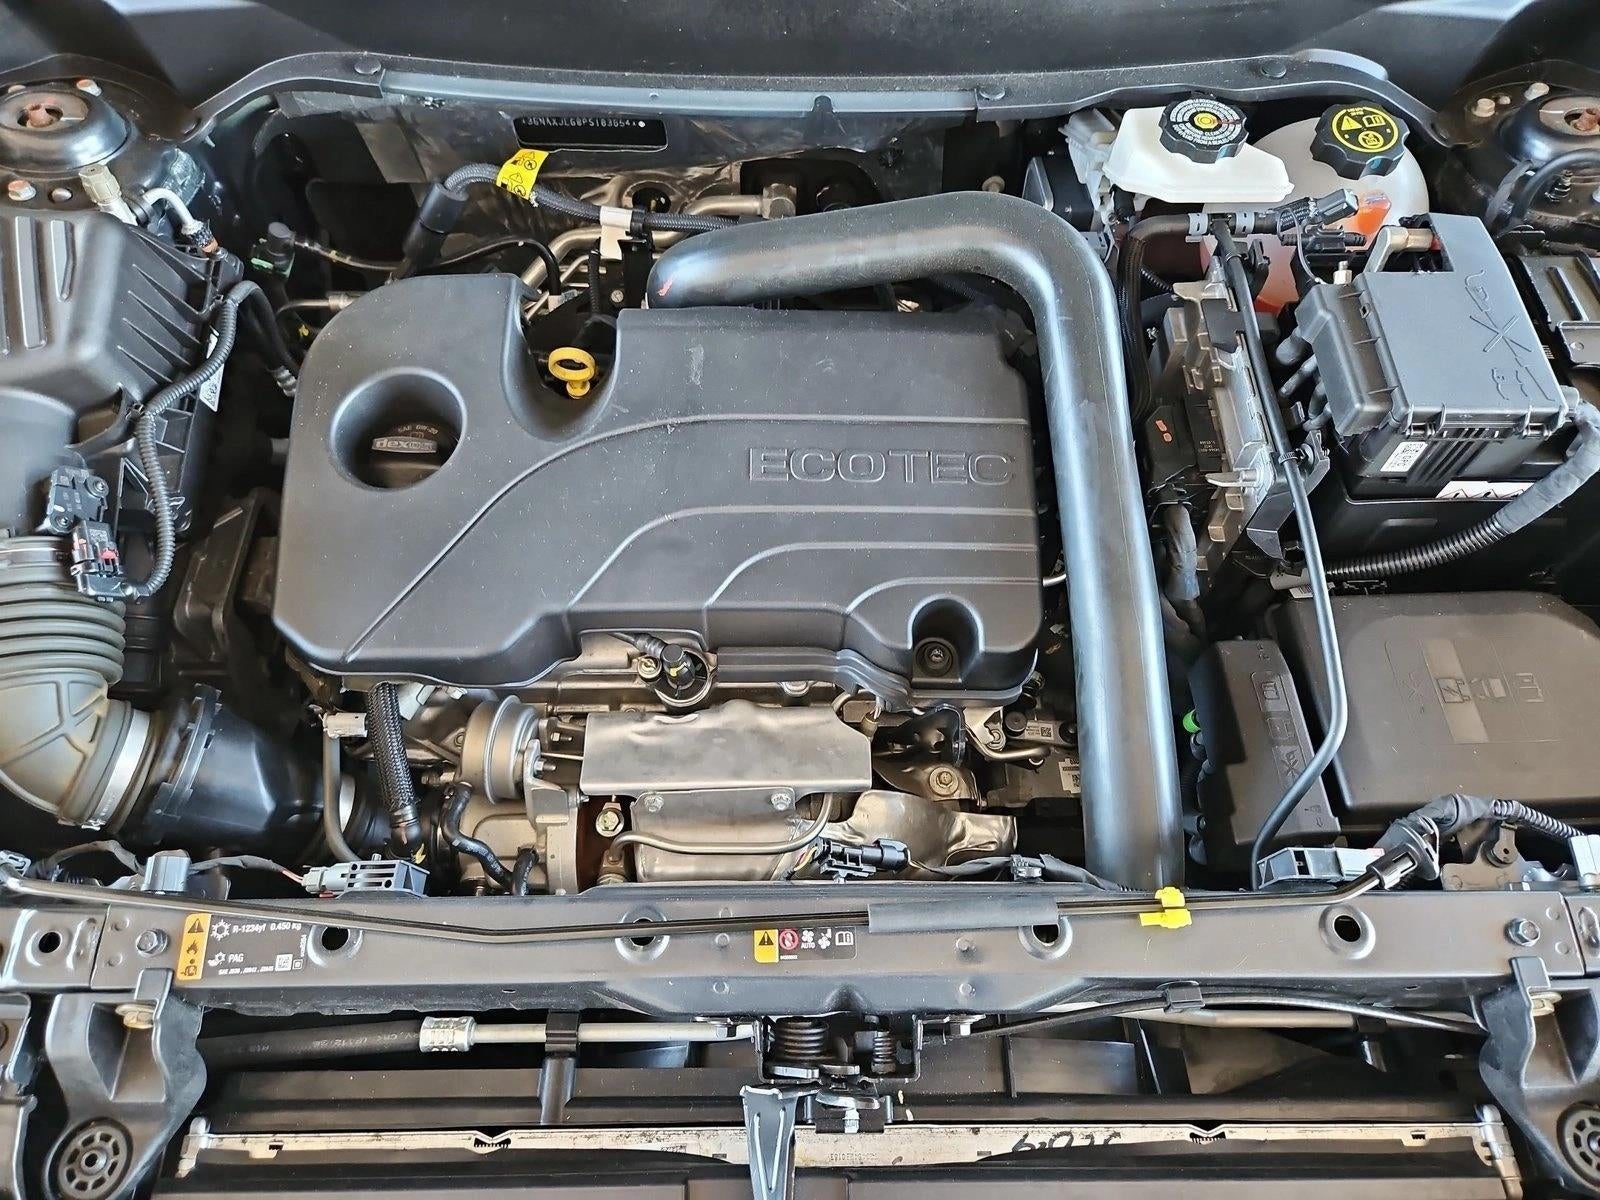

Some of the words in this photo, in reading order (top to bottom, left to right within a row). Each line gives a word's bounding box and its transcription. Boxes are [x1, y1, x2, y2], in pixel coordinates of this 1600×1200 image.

[749, 448, 1013, 486] ECOTEC
[270, 923, 291, 931] 0.450
[228, 953, 244, 963] PAG
